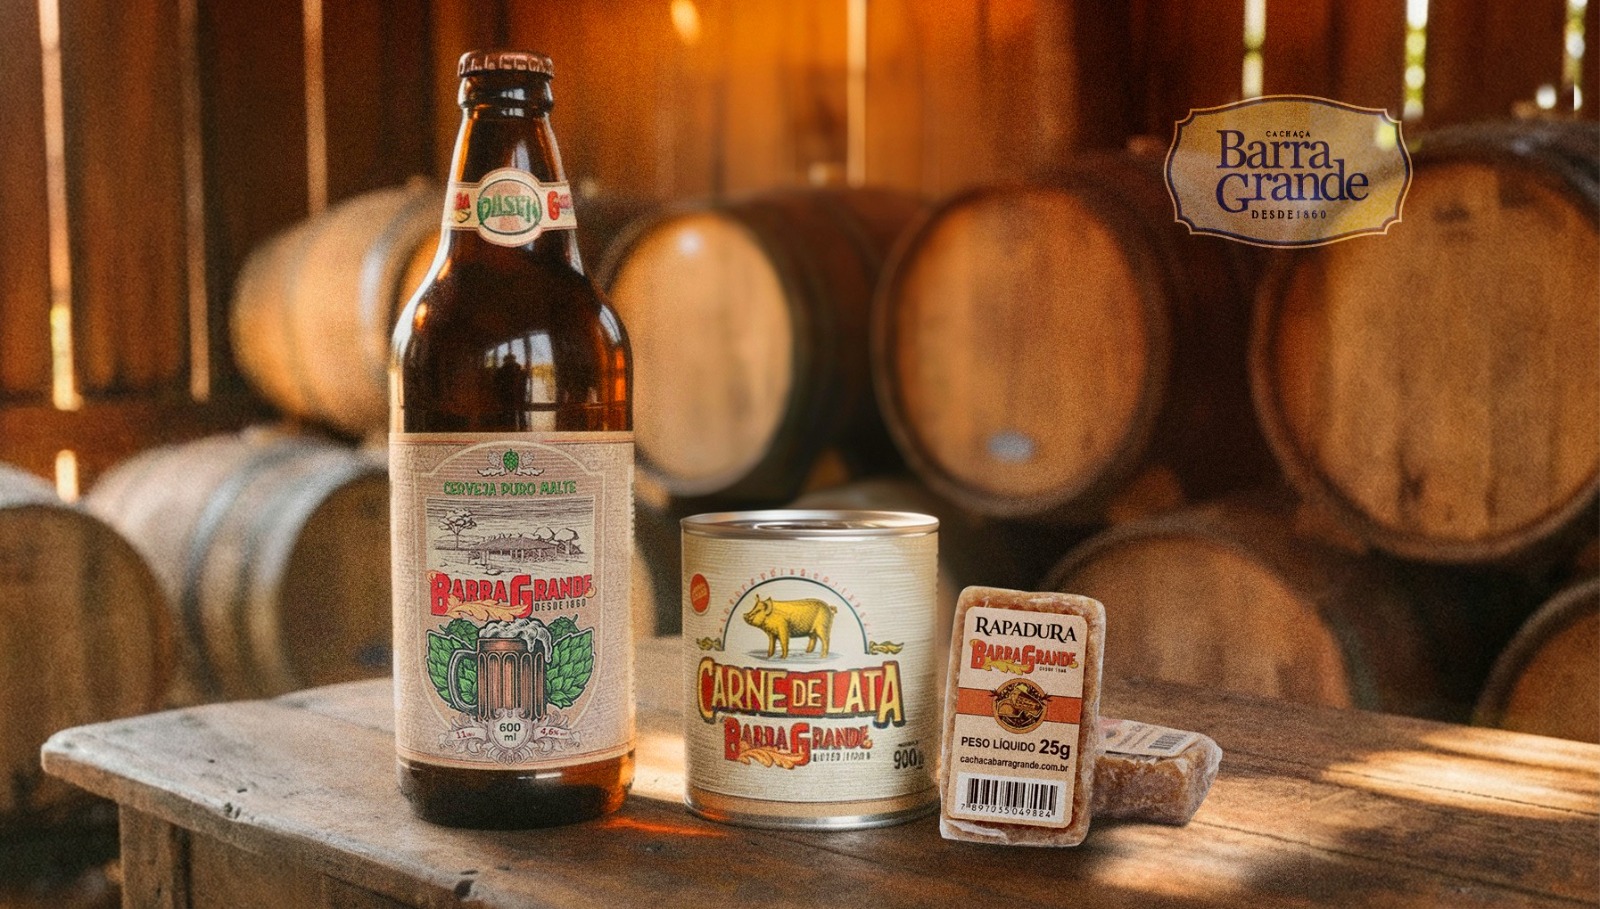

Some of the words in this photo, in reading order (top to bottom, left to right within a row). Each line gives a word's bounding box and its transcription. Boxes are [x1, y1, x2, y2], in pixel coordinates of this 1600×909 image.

[443, 480, 497, 497] CERVEJA
[500, 481, 536, 497] PURO
[540, 479, 577, 495] MALTE
[429, 572, 510, 617] BARRA
[509, 573, 594, 618] GRANDE
[534, 601, 564, 612] DESDE
[565, 598, 587, 609] 1860
[974, 616, 1078, 644] RAPADURA
[969, 639, 1021, 671] BARRA
[1020, 644, 1078, 674] GRANDE
[698, 658, 788, 721] CARNE
[791, 678, 823, 709] DE
[826, 663, 903, 725] LATA
[498, 722, 522, 733] 600
[503, 732, 517, 742] ml
[790, 721, 873, 766] GRANDE
[961, 736, 991, 749] PESO
[993, 737, 1036, 752] LÍQUIDO
[1038, 739, 1071, 760] 25g
[960, 755, 1069, 773] cachacabarragrande.com.br
